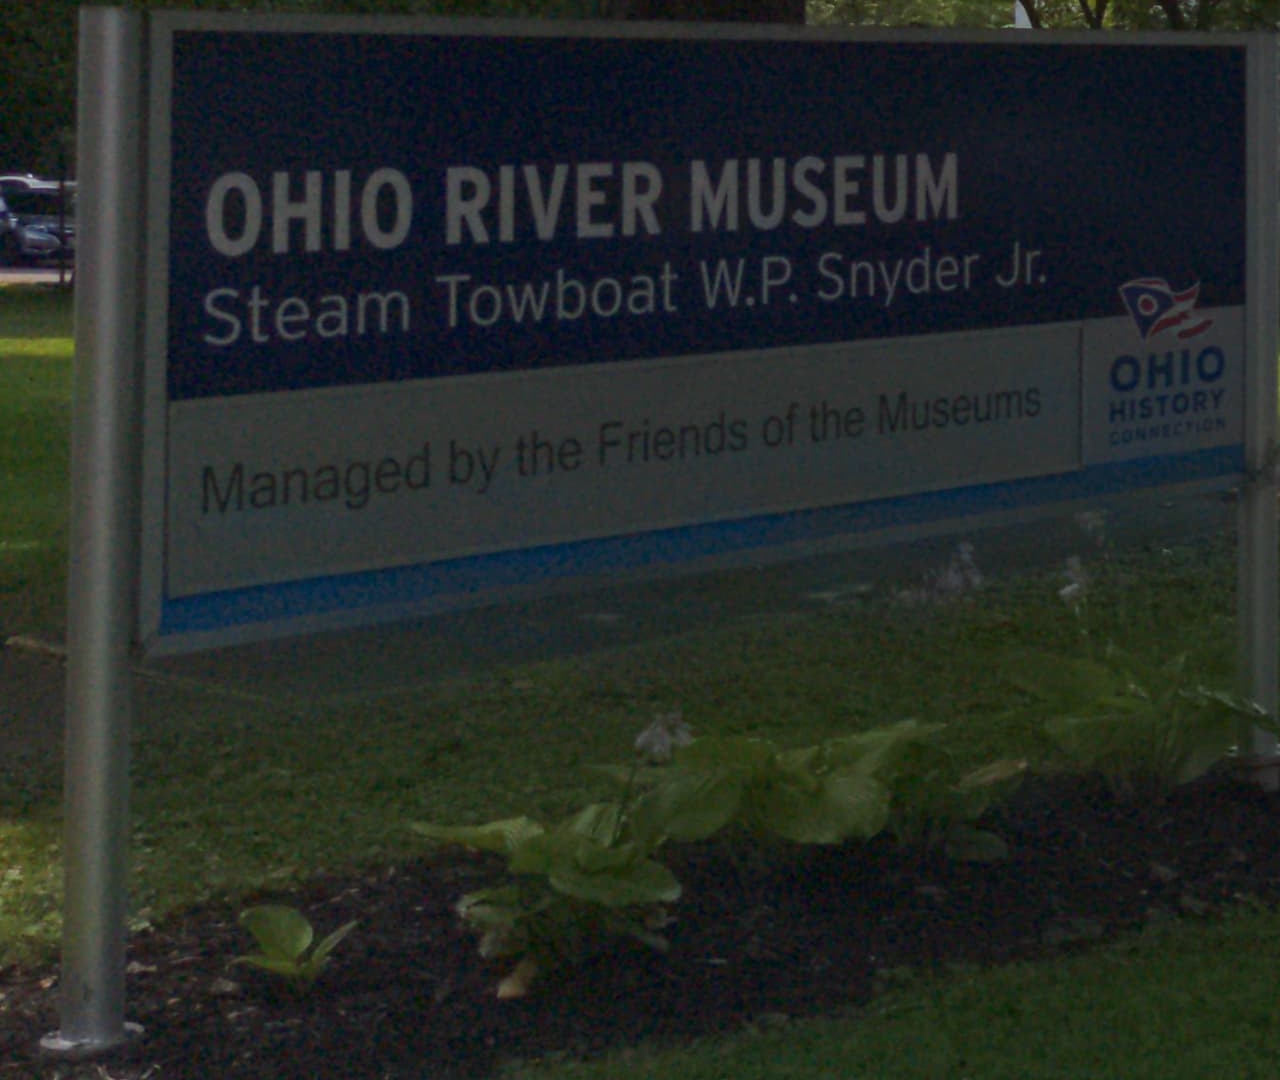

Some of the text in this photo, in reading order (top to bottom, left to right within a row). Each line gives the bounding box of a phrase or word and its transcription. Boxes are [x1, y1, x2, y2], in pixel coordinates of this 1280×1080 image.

[205, 152, 958, 257] OHIO RIVER MUSEUM
[204, 241, 1048, 347] Steam Towboat W.P. Snyder Jr.
[1108, 389, 1226, 424] HISTORY
[1109, 345, 1226, 393] OHIO
[202, 385, 1043, 514] Managed by the Friends of the Museums
[1109, 417, 1227, 446] CONNECTION
